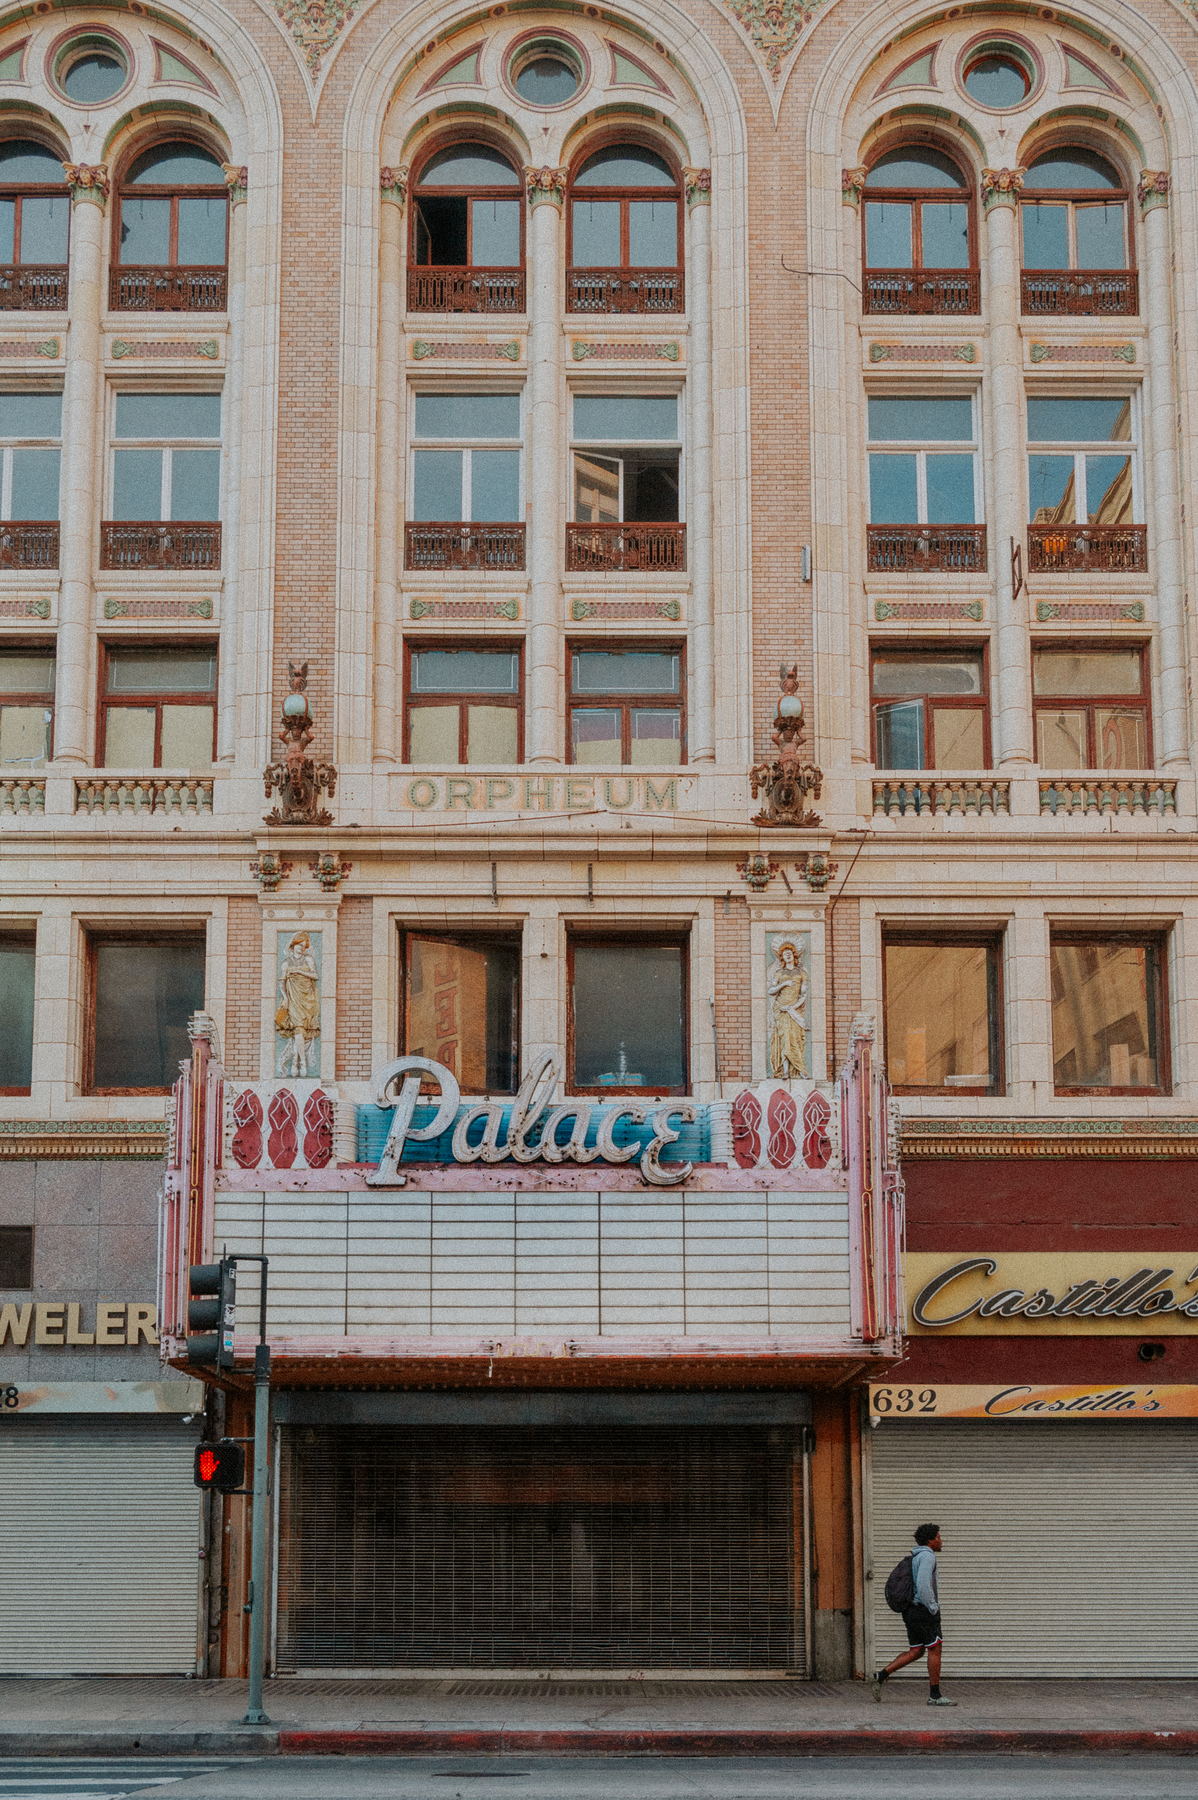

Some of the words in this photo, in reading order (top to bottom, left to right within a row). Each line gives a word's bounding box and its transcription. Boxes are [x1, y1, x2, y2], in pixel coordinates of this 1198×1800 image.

[406, 777, 680, 811] ORPHEUM
[365, 1050, 698, 1187] Palace
[0, 1302, 161, 1345] WELER
[0, 1386, 19, 1408] 8
[872, 1388, 938, 1413] 632
[984, 1386, 1166, 1416] Castillo's
